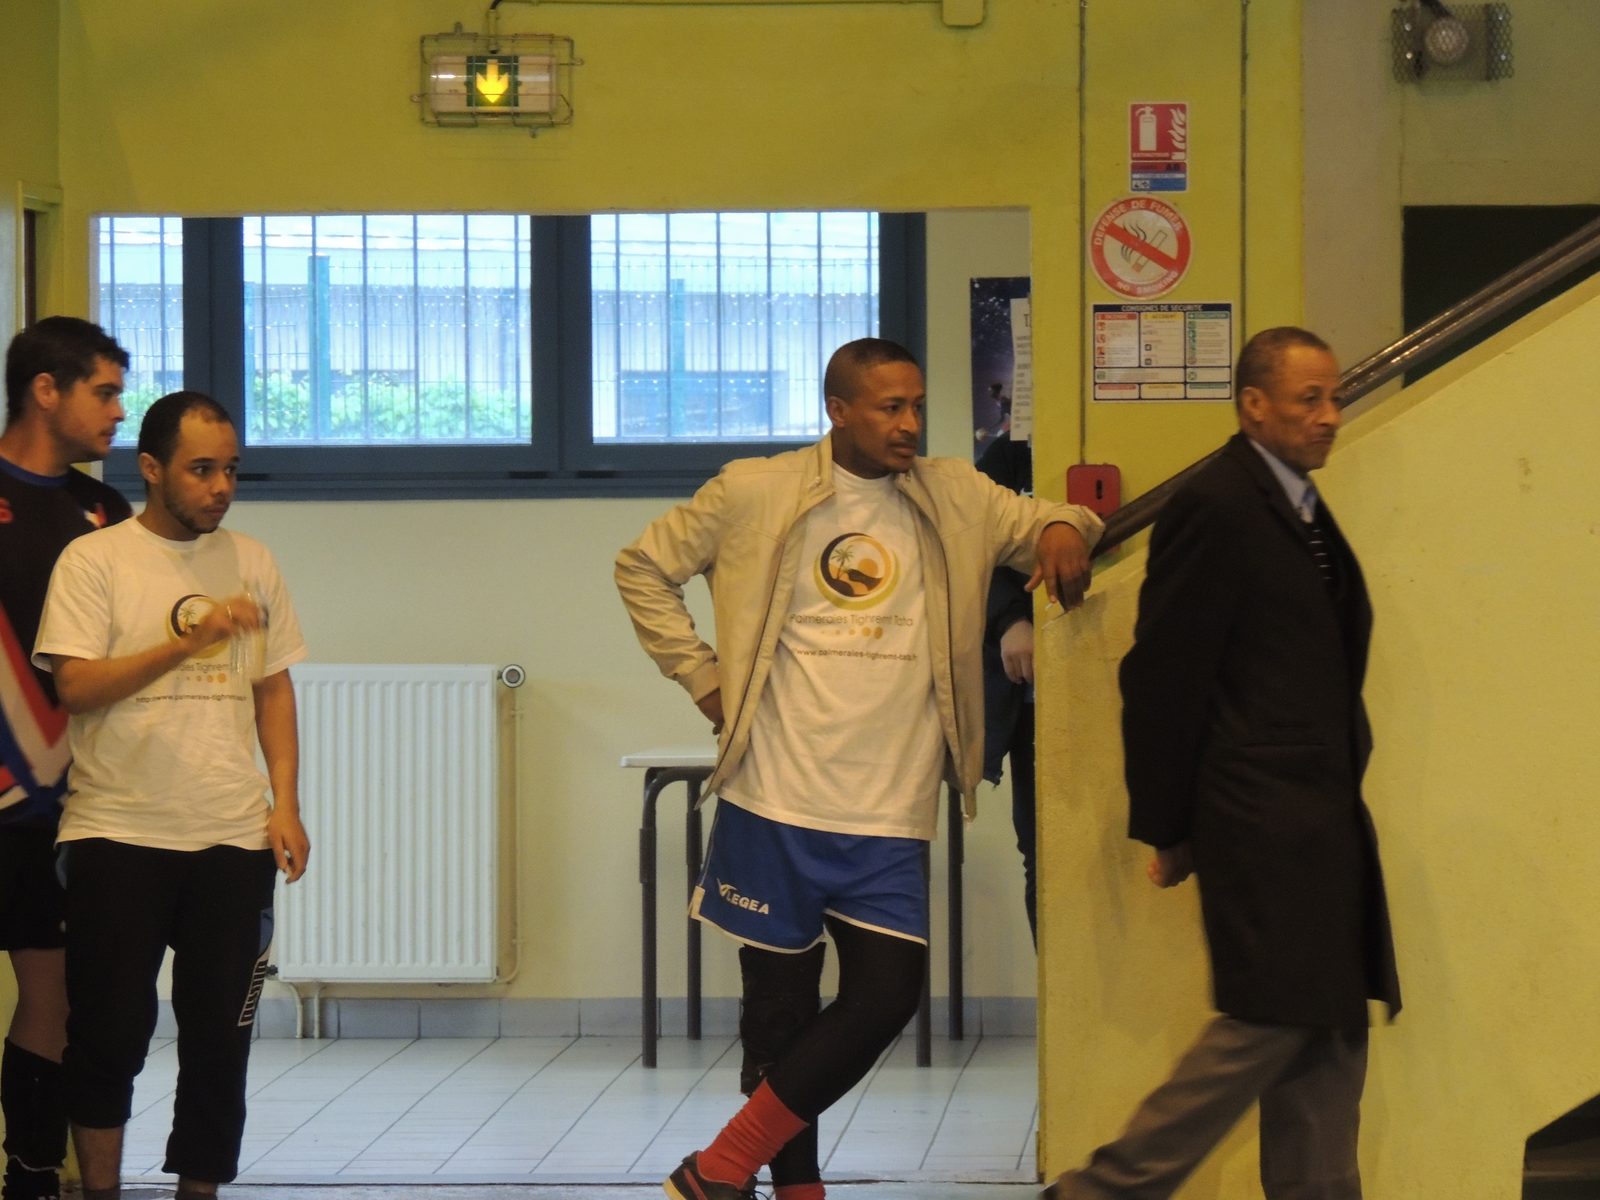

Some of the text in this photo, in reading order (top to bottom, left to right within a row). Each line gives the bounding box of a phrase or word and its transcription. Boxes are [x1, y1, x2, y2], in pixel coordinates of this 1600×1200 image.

[1093, 200, 1184, 247] DEFENSE DE FUMER
[1121, 304, 1159, 312] CONSIGNES
[1160, 304, 1169, 312] DE
[195, 661, 230, 674] Tighrem
[725, 889, 770, 915] LEGEA
